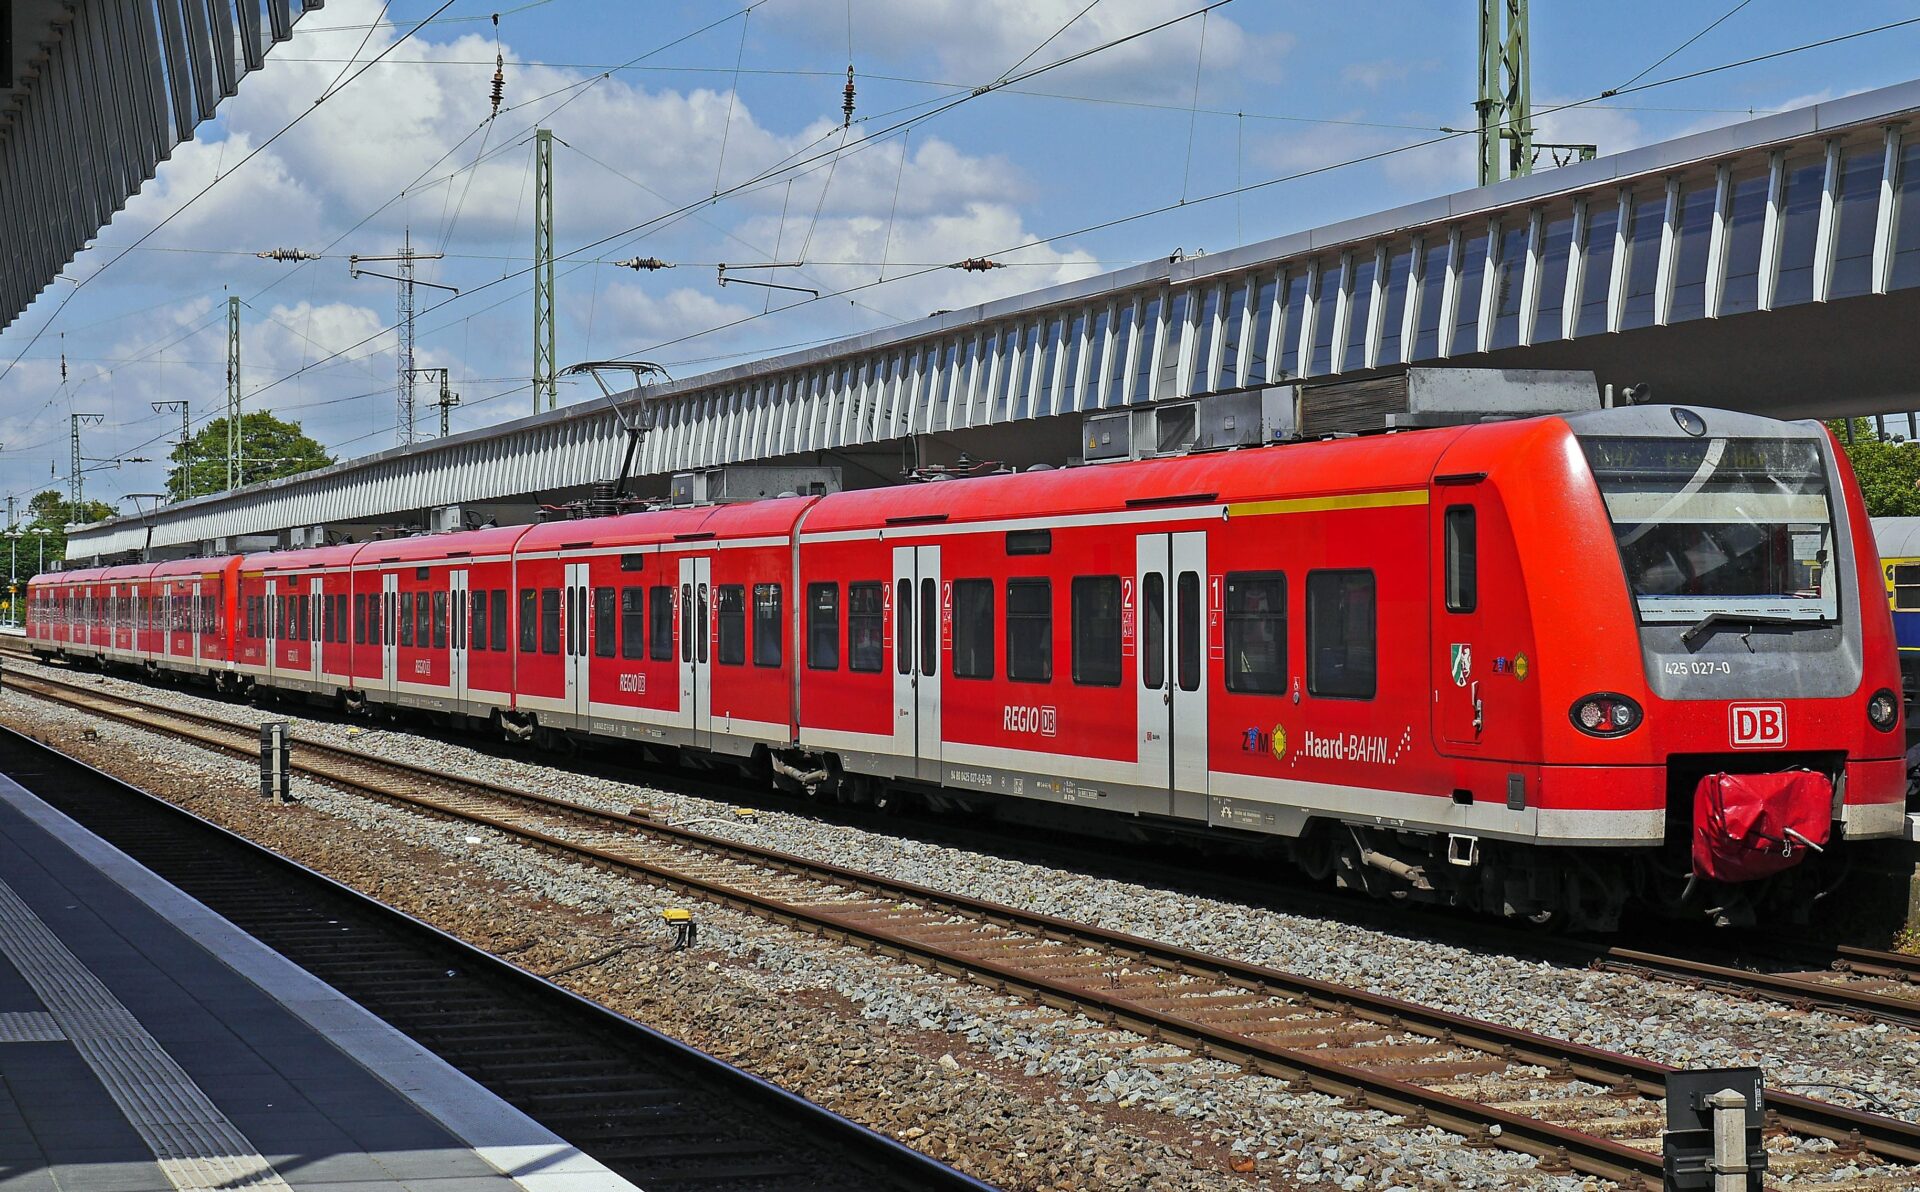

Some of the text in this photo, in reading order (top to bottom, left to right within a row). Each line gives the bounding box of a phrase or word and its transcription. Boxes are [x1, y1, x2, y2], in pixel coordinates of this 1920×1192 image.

[590, 590, 595, 608] 2
[673, 588, 678, 608] 2
[713, 588, 717, 608] 2
[884, 584, 890, 608] 2
[943, 582, 951, 608] 2
[1124, 579, 1132, 608] 2
[1212, 578, 1219, 609] 1
[1665, 661, 1731, 674] 425 027-0
[620, 673, 637, 692] REGIO
[1434, 689, 1439, 703] 1
[1003, 705, 1055, 733] REGIO DB
[1734, 708, 1781, 742] DB
[1305, 730, 1388, 764] Haard-BAHN
